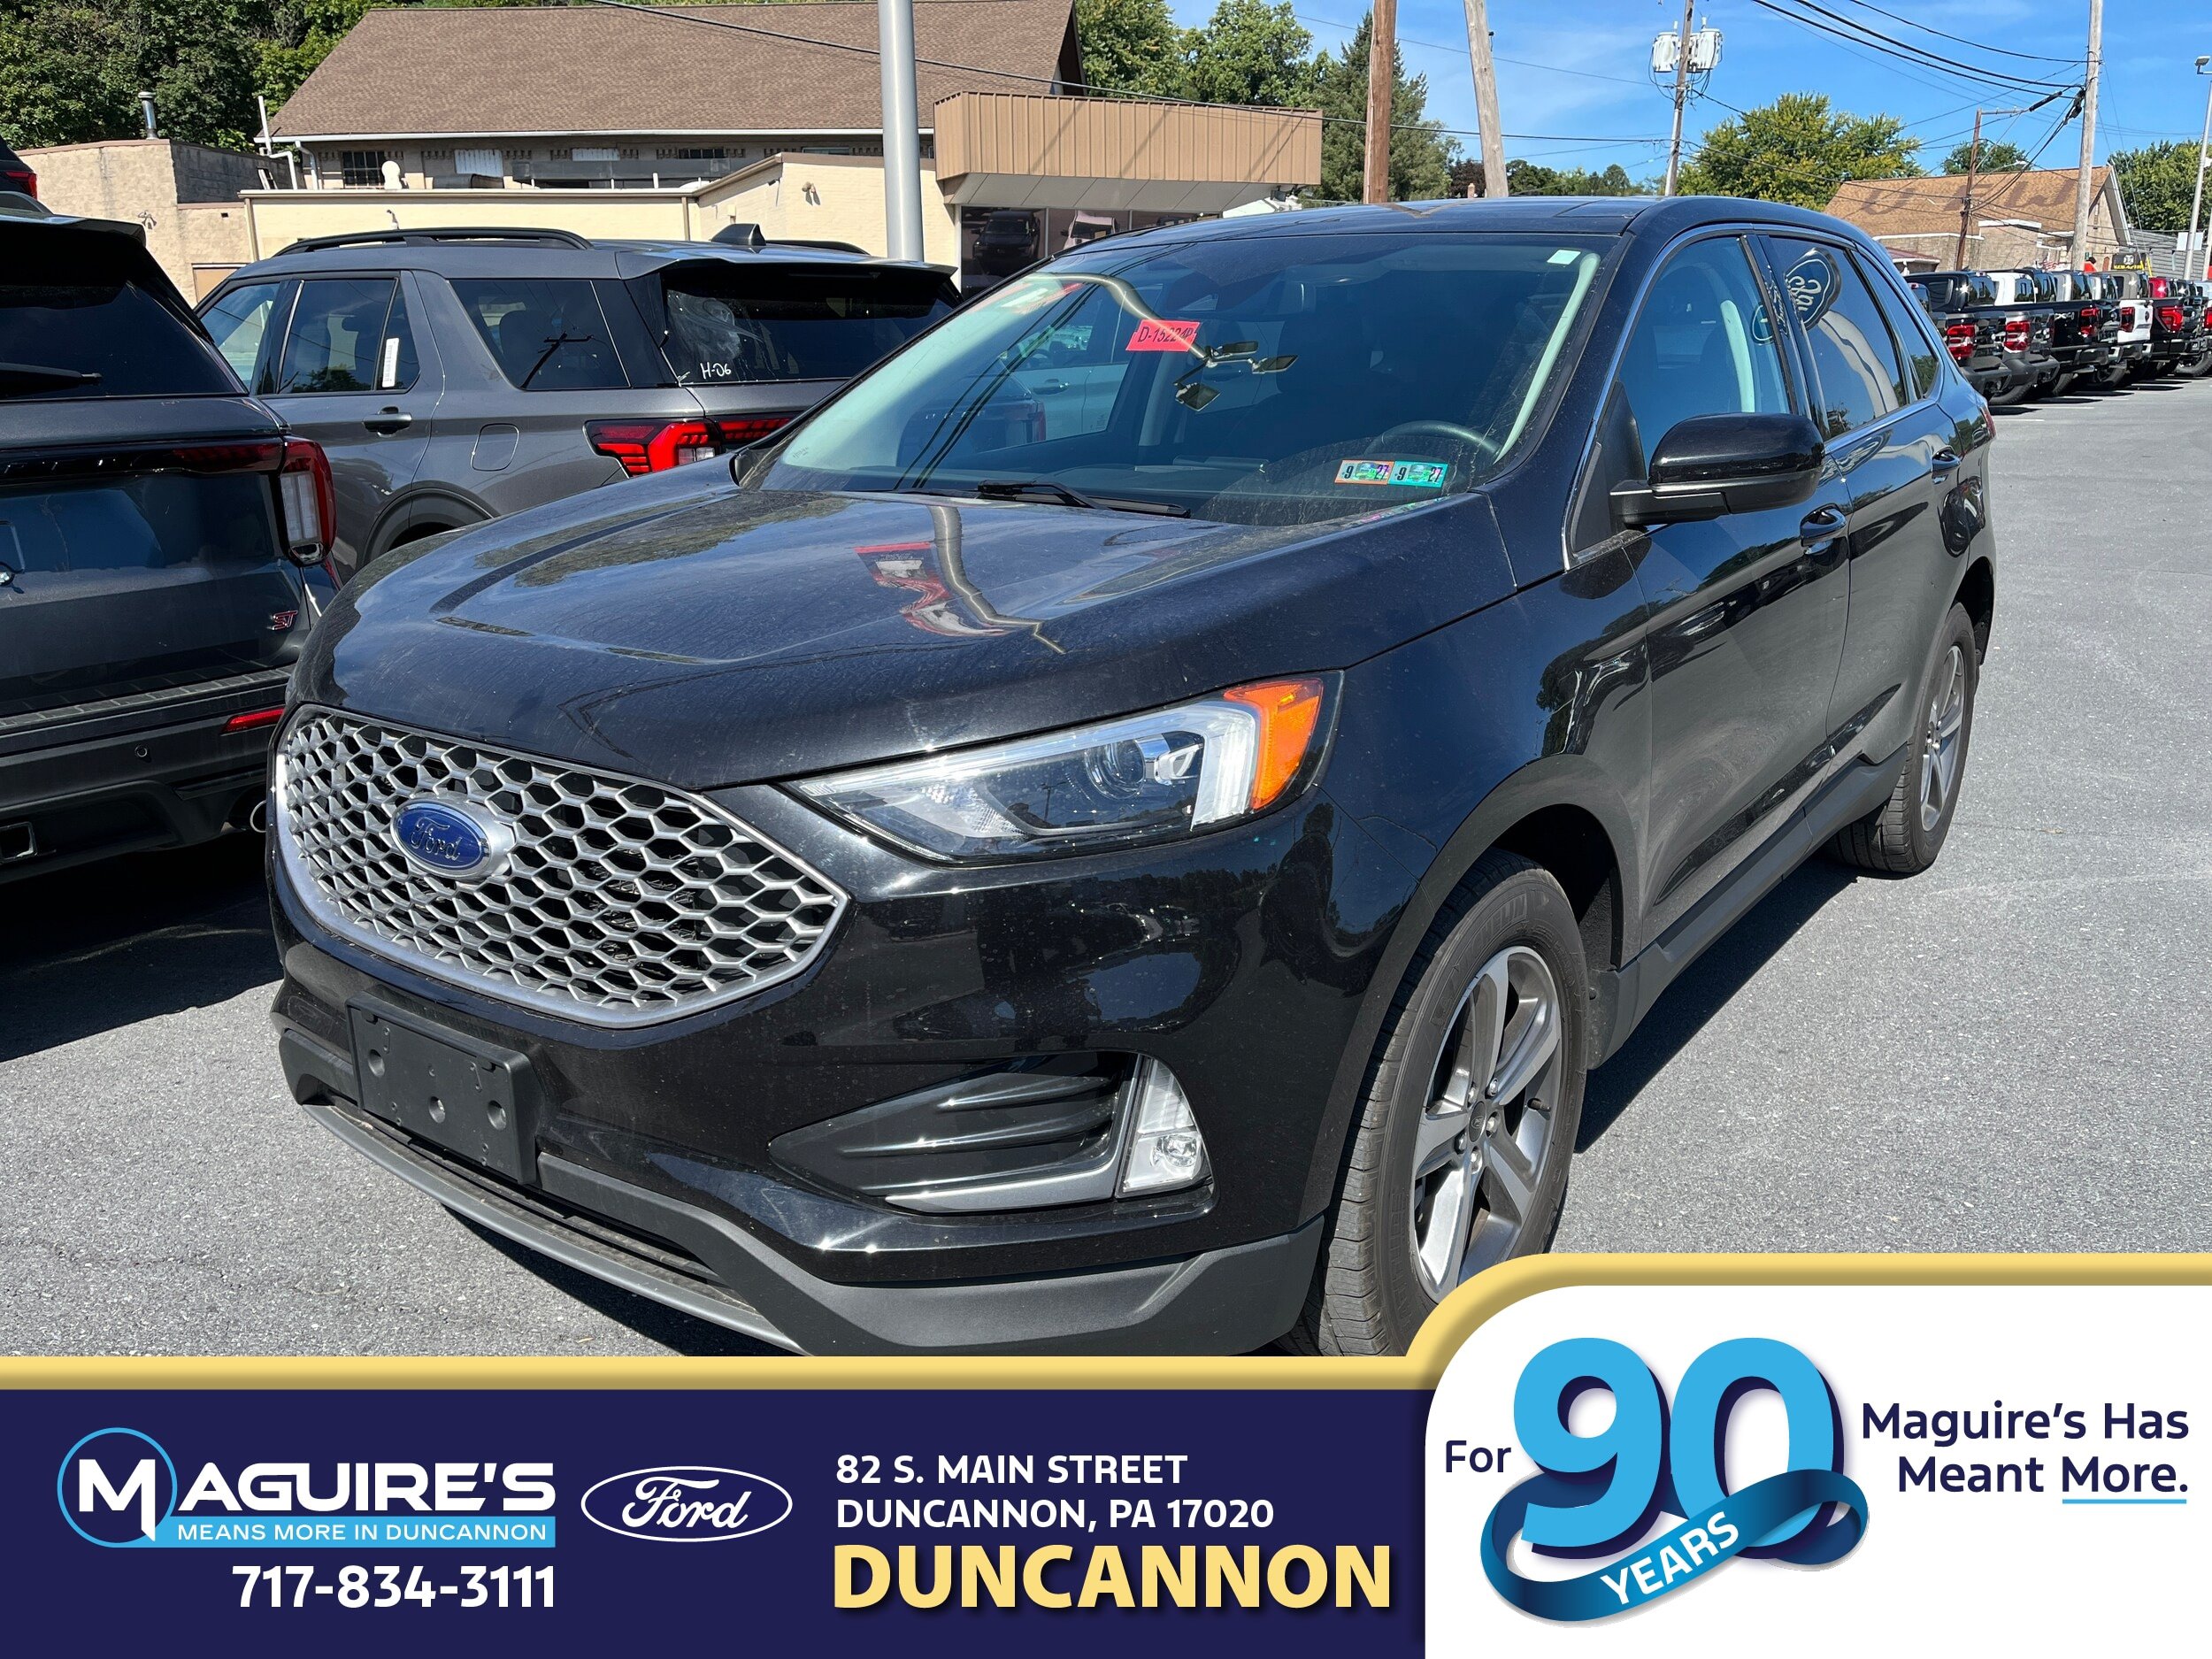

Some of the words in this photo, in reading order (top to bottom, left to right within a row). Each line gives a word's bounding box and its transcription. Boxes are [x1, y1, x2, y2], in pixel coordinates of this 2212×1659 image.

[700, 362, 732, 380] H-06
[272, 610, 299, 631] ST
[410, 816, 463, 861] Ford
